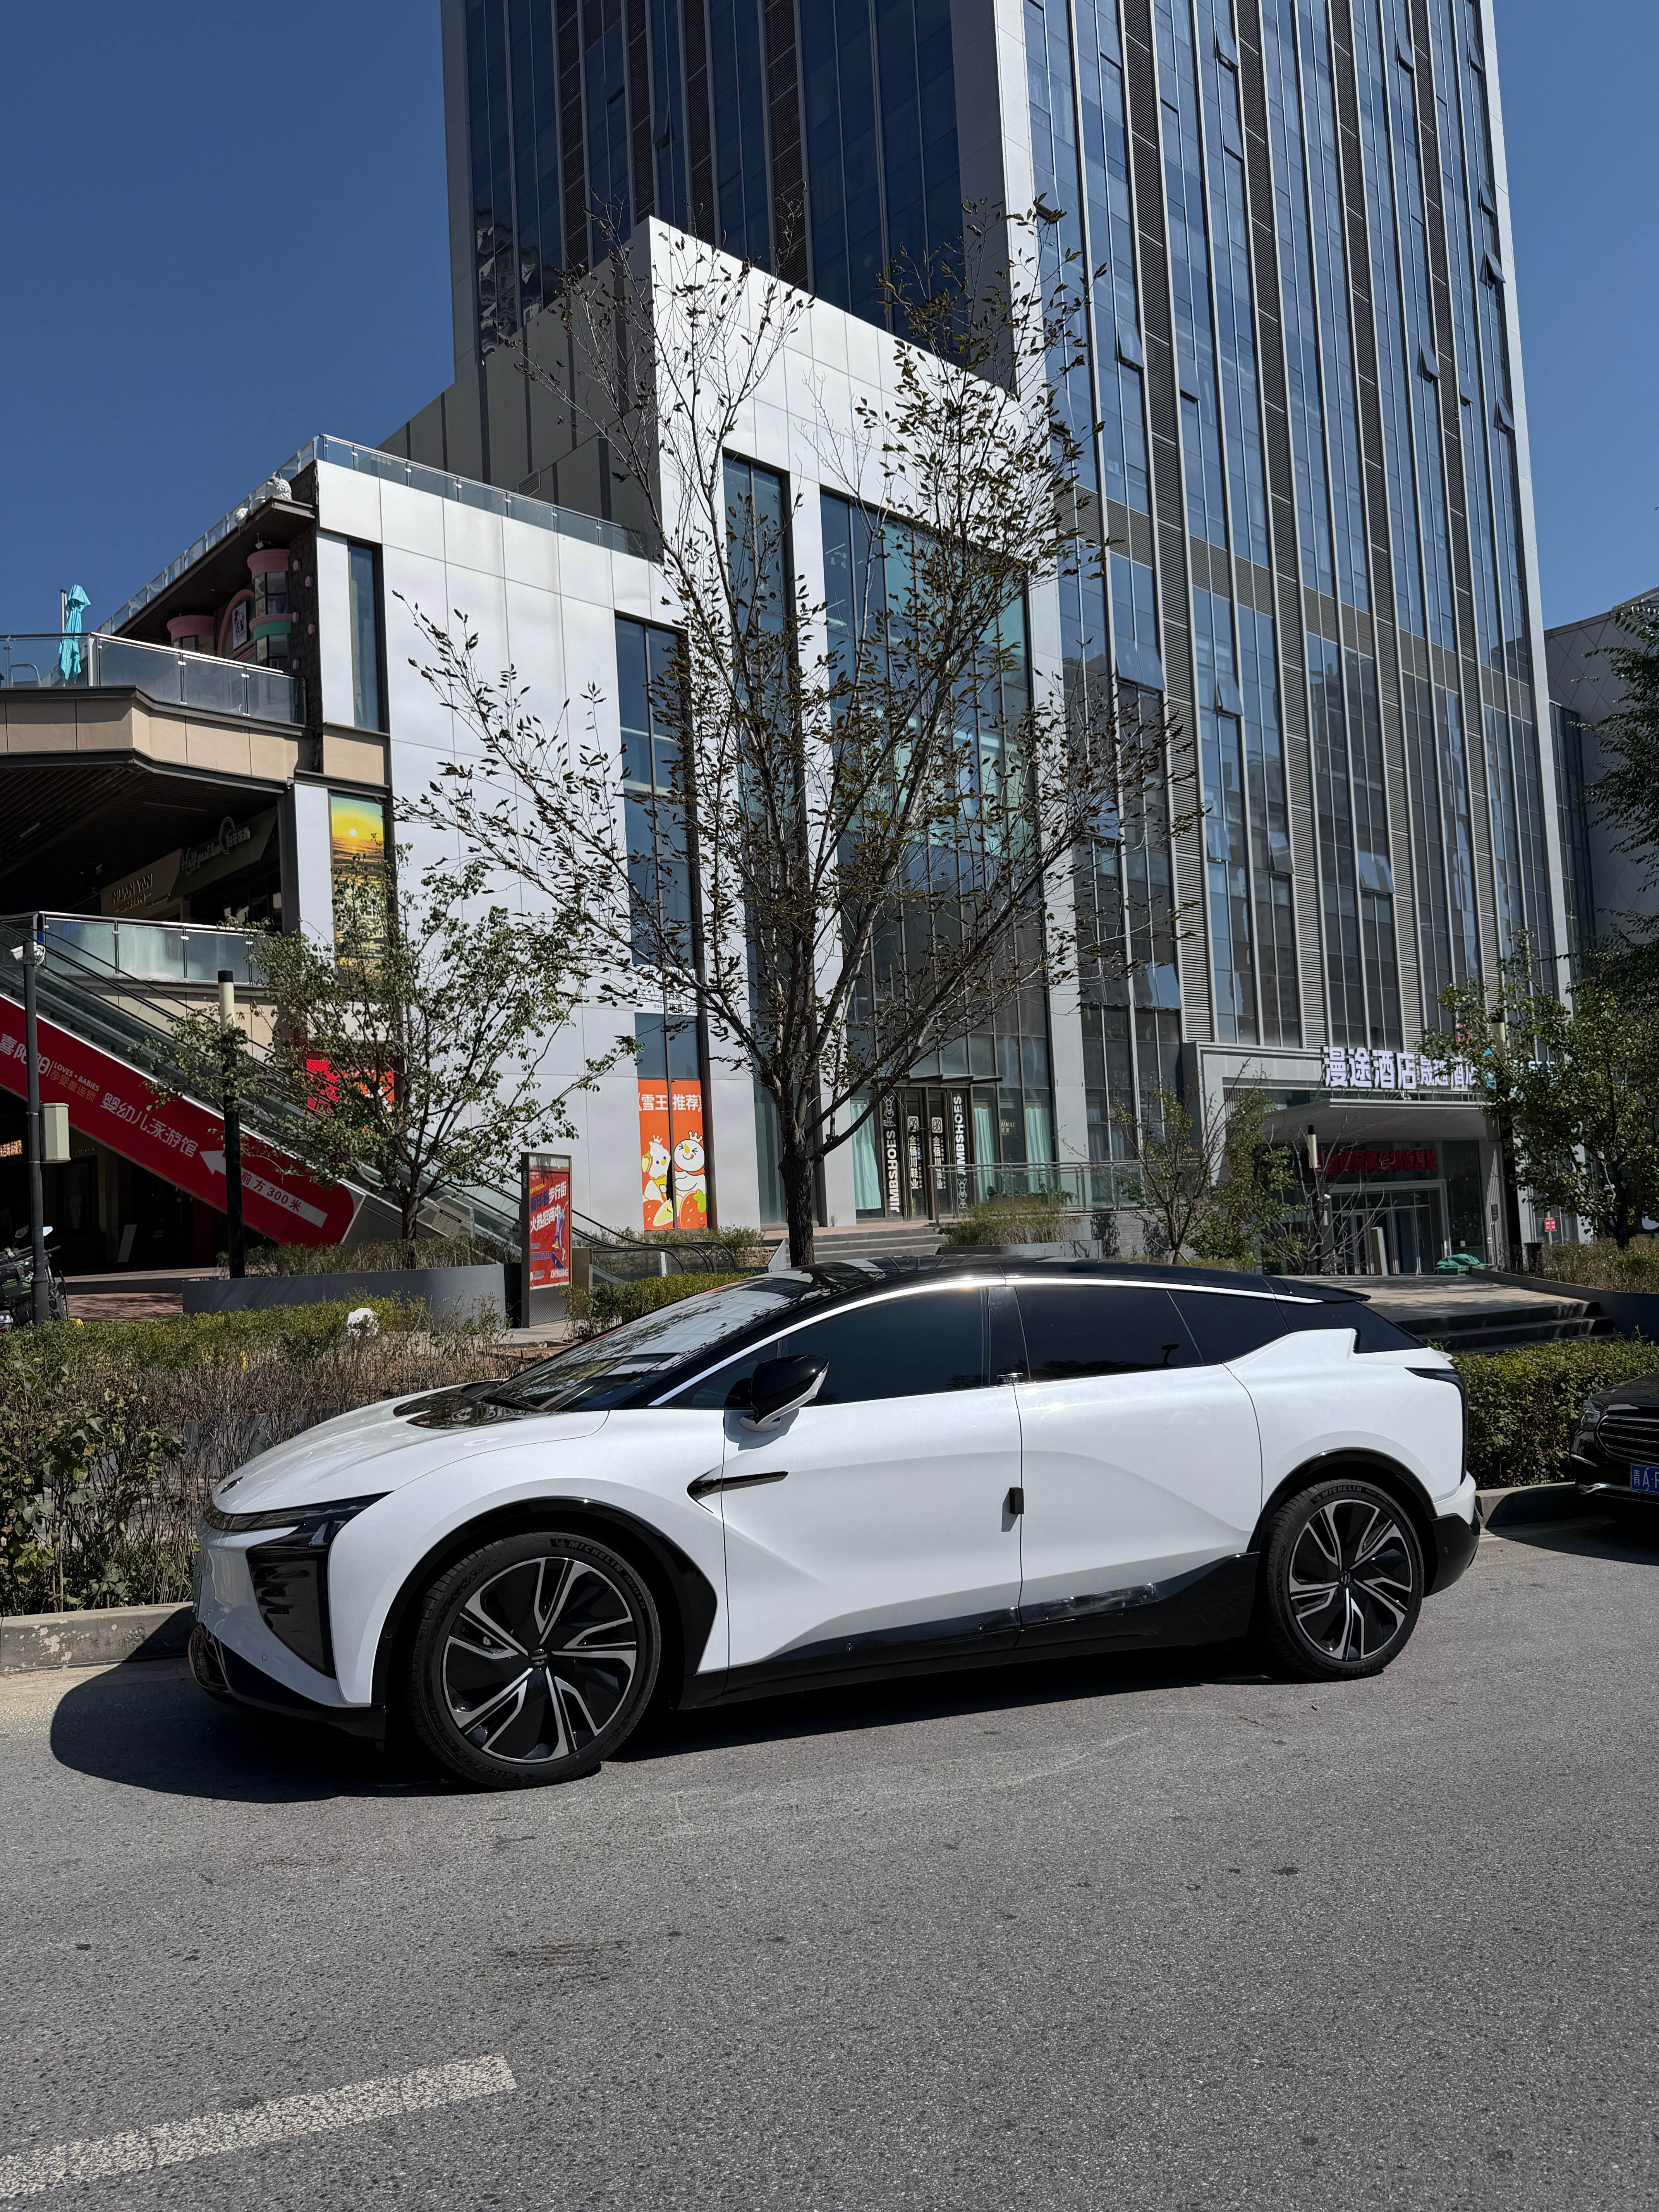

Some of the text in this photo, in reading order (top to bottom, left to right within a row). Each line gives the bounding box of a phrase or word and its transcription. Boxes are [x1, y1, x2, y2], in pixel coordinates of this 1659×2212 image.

[53, 1062, 100, 1092] LOVES BABIES
[1323, 1046, 1416, 1089] 漫途酒店
[50, 1070, 96, 1103] 孕婴童连锁
[641, 1093, 699, 1111] 雪王推荐
[100, 1092, 199, 1158] 婴幼儿泳游馆
[954, 1096, 966, 1176] JIMBSHOES
[886, 1130, 900, 1212] JIMBSHOES
[909, 1135, 919, 1189] 金佰川鞋业
[241, 1171, 301, 1212] 前方300米
[530, 1203, 561, 1234] 火热招商中
[1322, 1485, 1362, 1498] MICHELIN
[568, 1540, 623, 1573] MICHELIN
